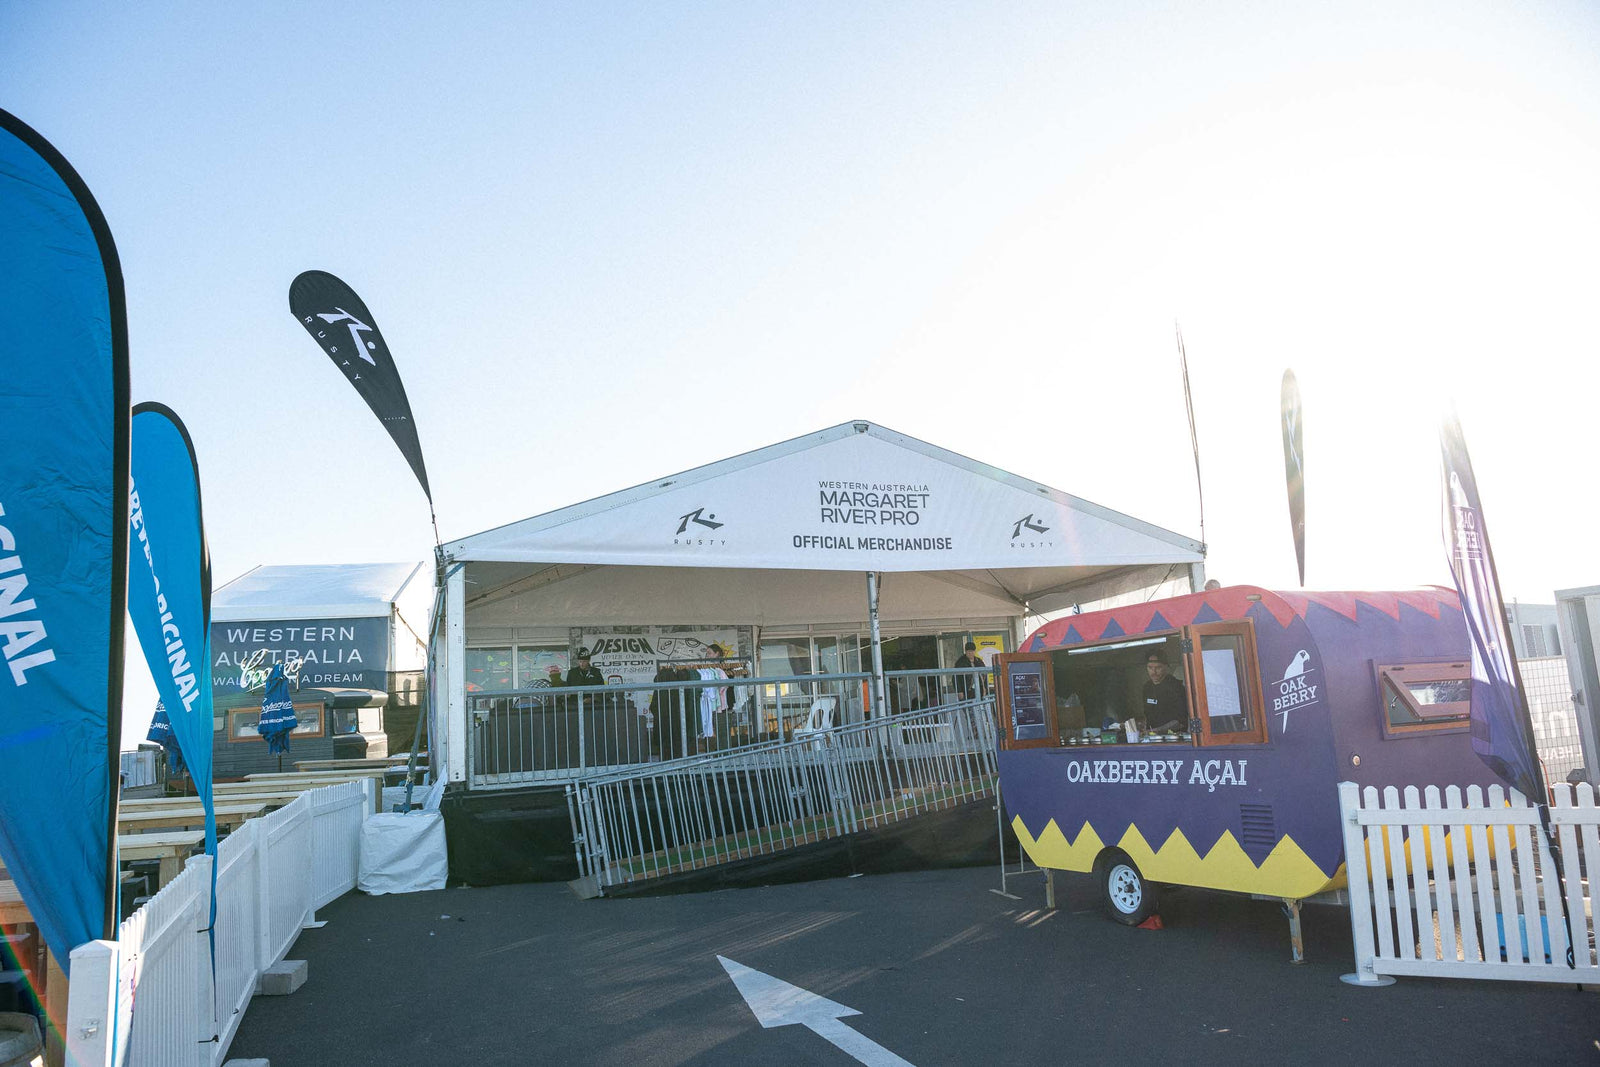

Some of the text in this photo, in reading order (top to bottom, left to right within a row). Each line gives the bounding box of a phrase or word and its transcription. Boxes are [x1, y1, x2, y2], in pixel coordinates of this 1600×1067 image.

[305, 315, 361, 380] RUSTY
[819, 481, 929, 492] WESTERN AUSTRALIA
[820, 490, 930, 509] MARGARET
[821, 508, 920, 526] RIVER PRO
[793, 535, 952, 551] OFFICIAL MERCHANDISE
[227, 626, 355, 644] WESTERN
[591, 638, 656, 656] DESIGN
[215, 648, 363, 667] AUSTRALIA
[314, 673, 363, 683] DREAM
[602, 667, 621, 675] USTY
[1280, 675, 1308, 695] OAK
[1273, 685, 1317, 711] BERRY
[1067, 760, 1248, 793] OAKBERRY AÇAI
